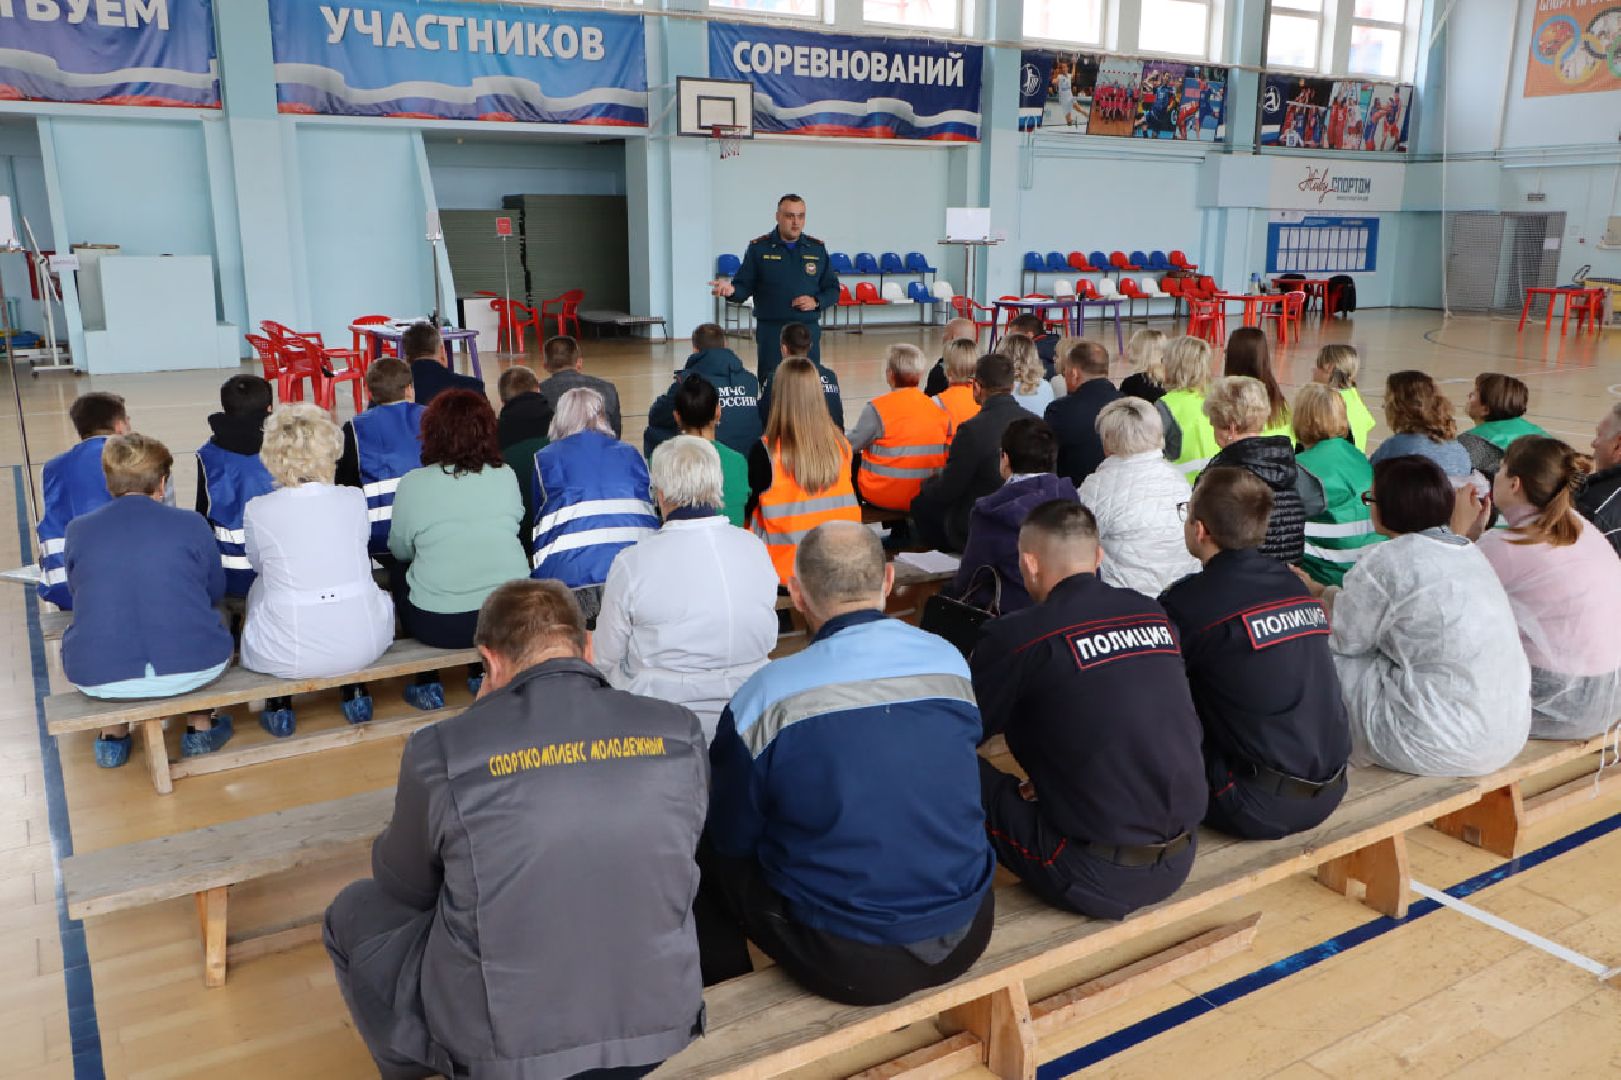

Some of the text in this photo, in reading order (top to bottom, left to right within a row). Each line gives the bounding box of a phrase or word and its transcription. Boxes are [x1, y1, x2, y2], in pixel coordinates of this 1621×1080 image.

[319, 6, 605, 61] УЧАСТНИКОВ
[733, 40, 964, 87] СОРЕВНОВАНИЙ
[718, 385, 746, 397] МЧС
[718, 396, 757, 408] ОССИИ
[1252, 606, 1328, 639] ПОЛИЦИЯ
[1076, 625, 1174, 660] ПОЛИЦИЯ
[488, 740, 588, 777] СПОРТКОМПЛЕКС
